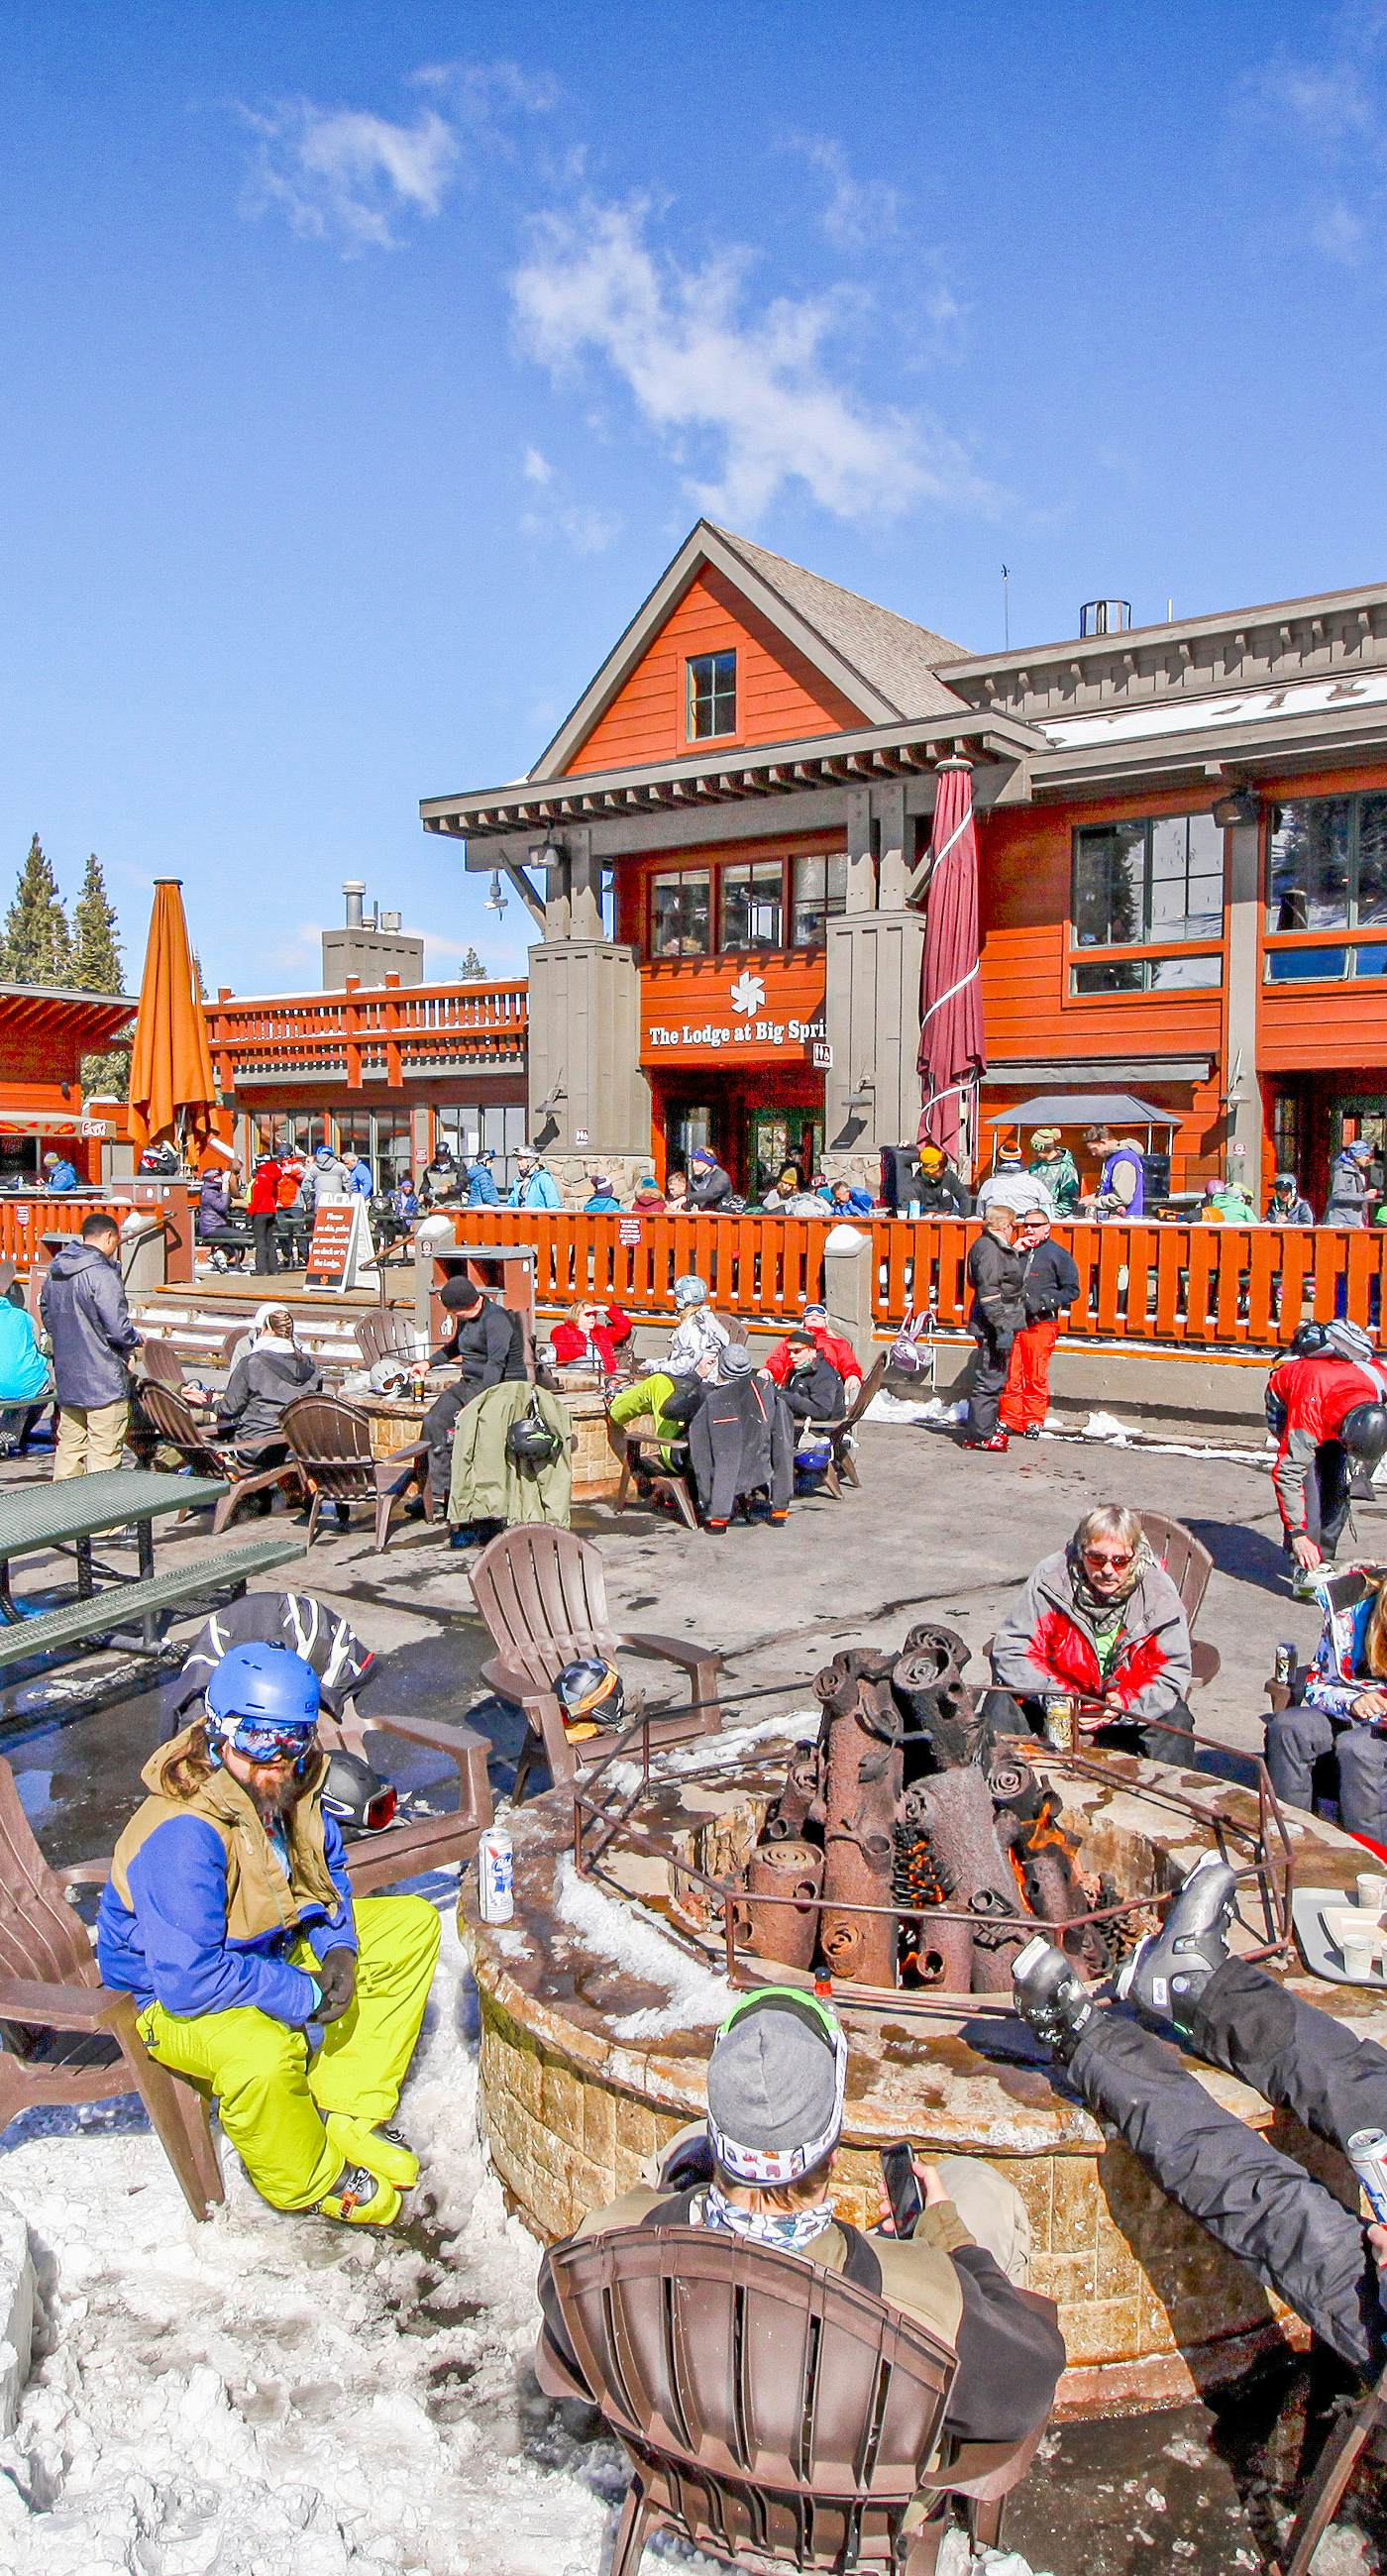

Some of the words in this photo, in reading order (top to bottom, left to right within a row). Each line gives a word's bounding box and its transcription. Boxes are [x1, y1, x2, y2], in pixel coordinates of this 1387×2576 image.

[649, 1027, 679, 1046] The
[683, 1024, 730, 1047] Lodge
[734, 1023, 752, 1041] at
[755, 1021, 786, 1044] Big
[788, 1019, 827, 1043] Spri
